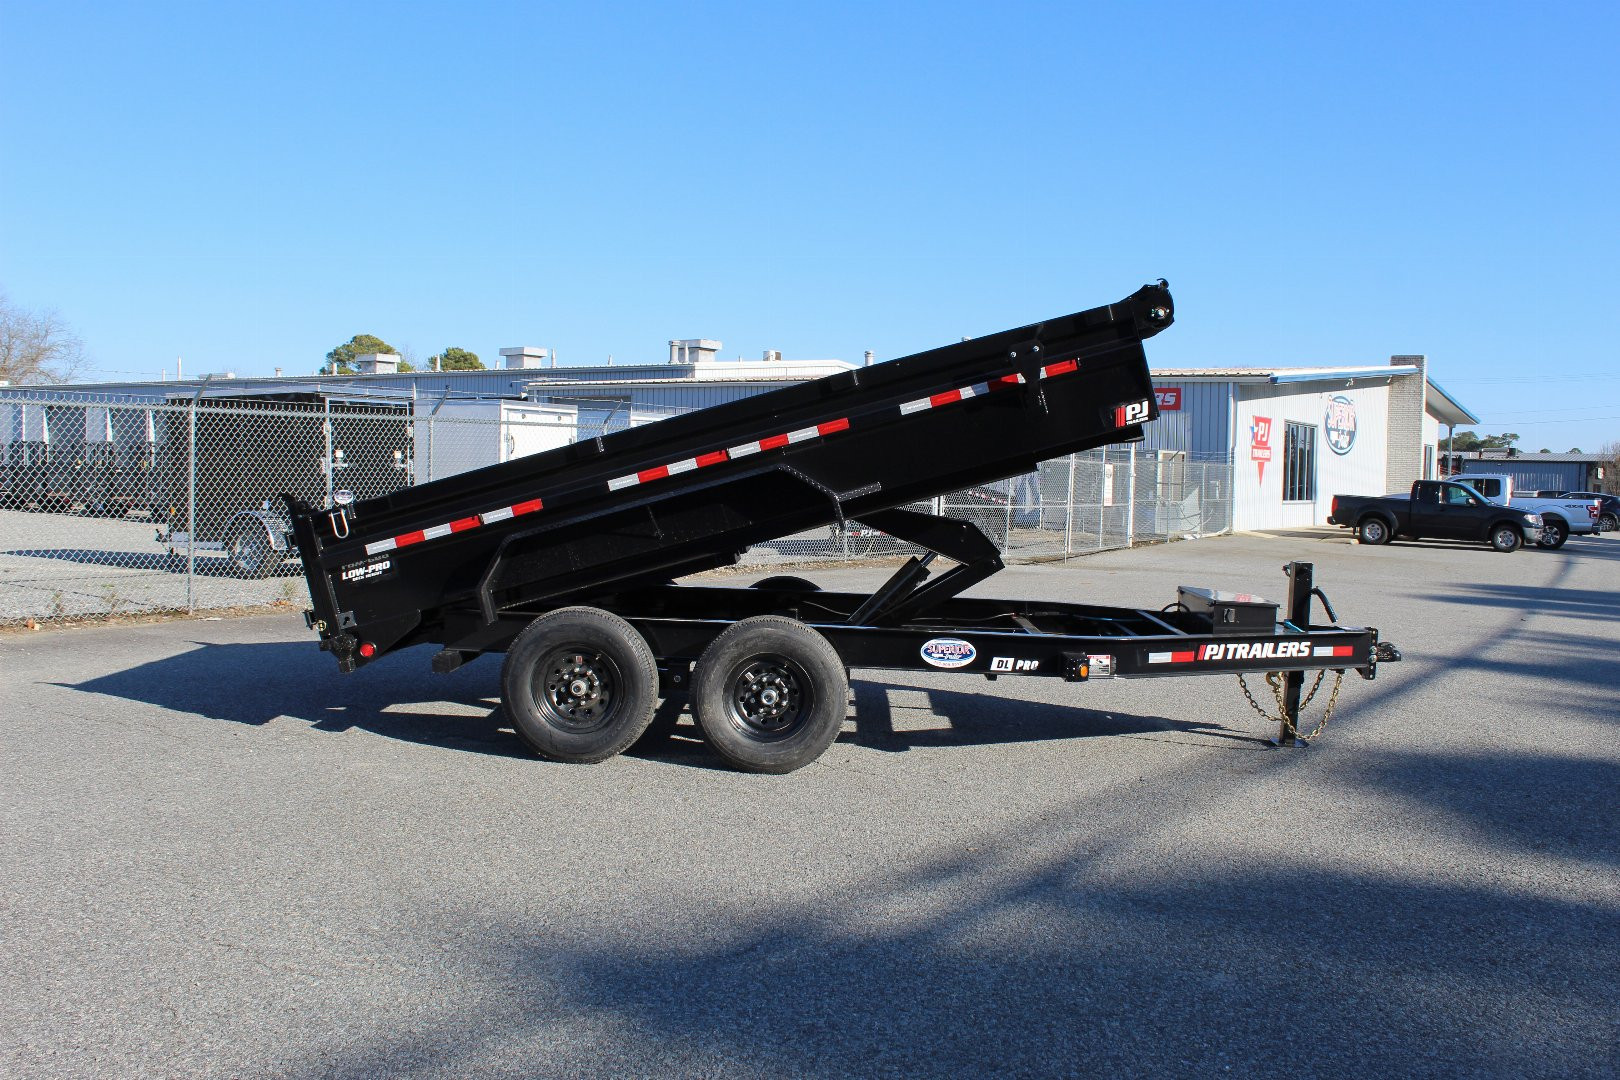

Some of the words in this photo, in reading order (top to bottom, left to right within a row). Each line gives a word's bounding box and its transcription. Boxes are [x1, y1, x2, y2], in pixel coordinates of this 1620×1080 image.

[1126, 401, 1149, 421] PJ
[1257, 421, 1270, 442] PJ
[342, 560, 391, 580] LOW-PRO
[927, 643, 971, 655] SUPERIOR
[1203, 644, 1226, 660] PJ
[1226, 641, 1311, 659] TRAILERS
[996, 659, 1009, 669] DL
[1015, 659, 1040, 671] PRO
